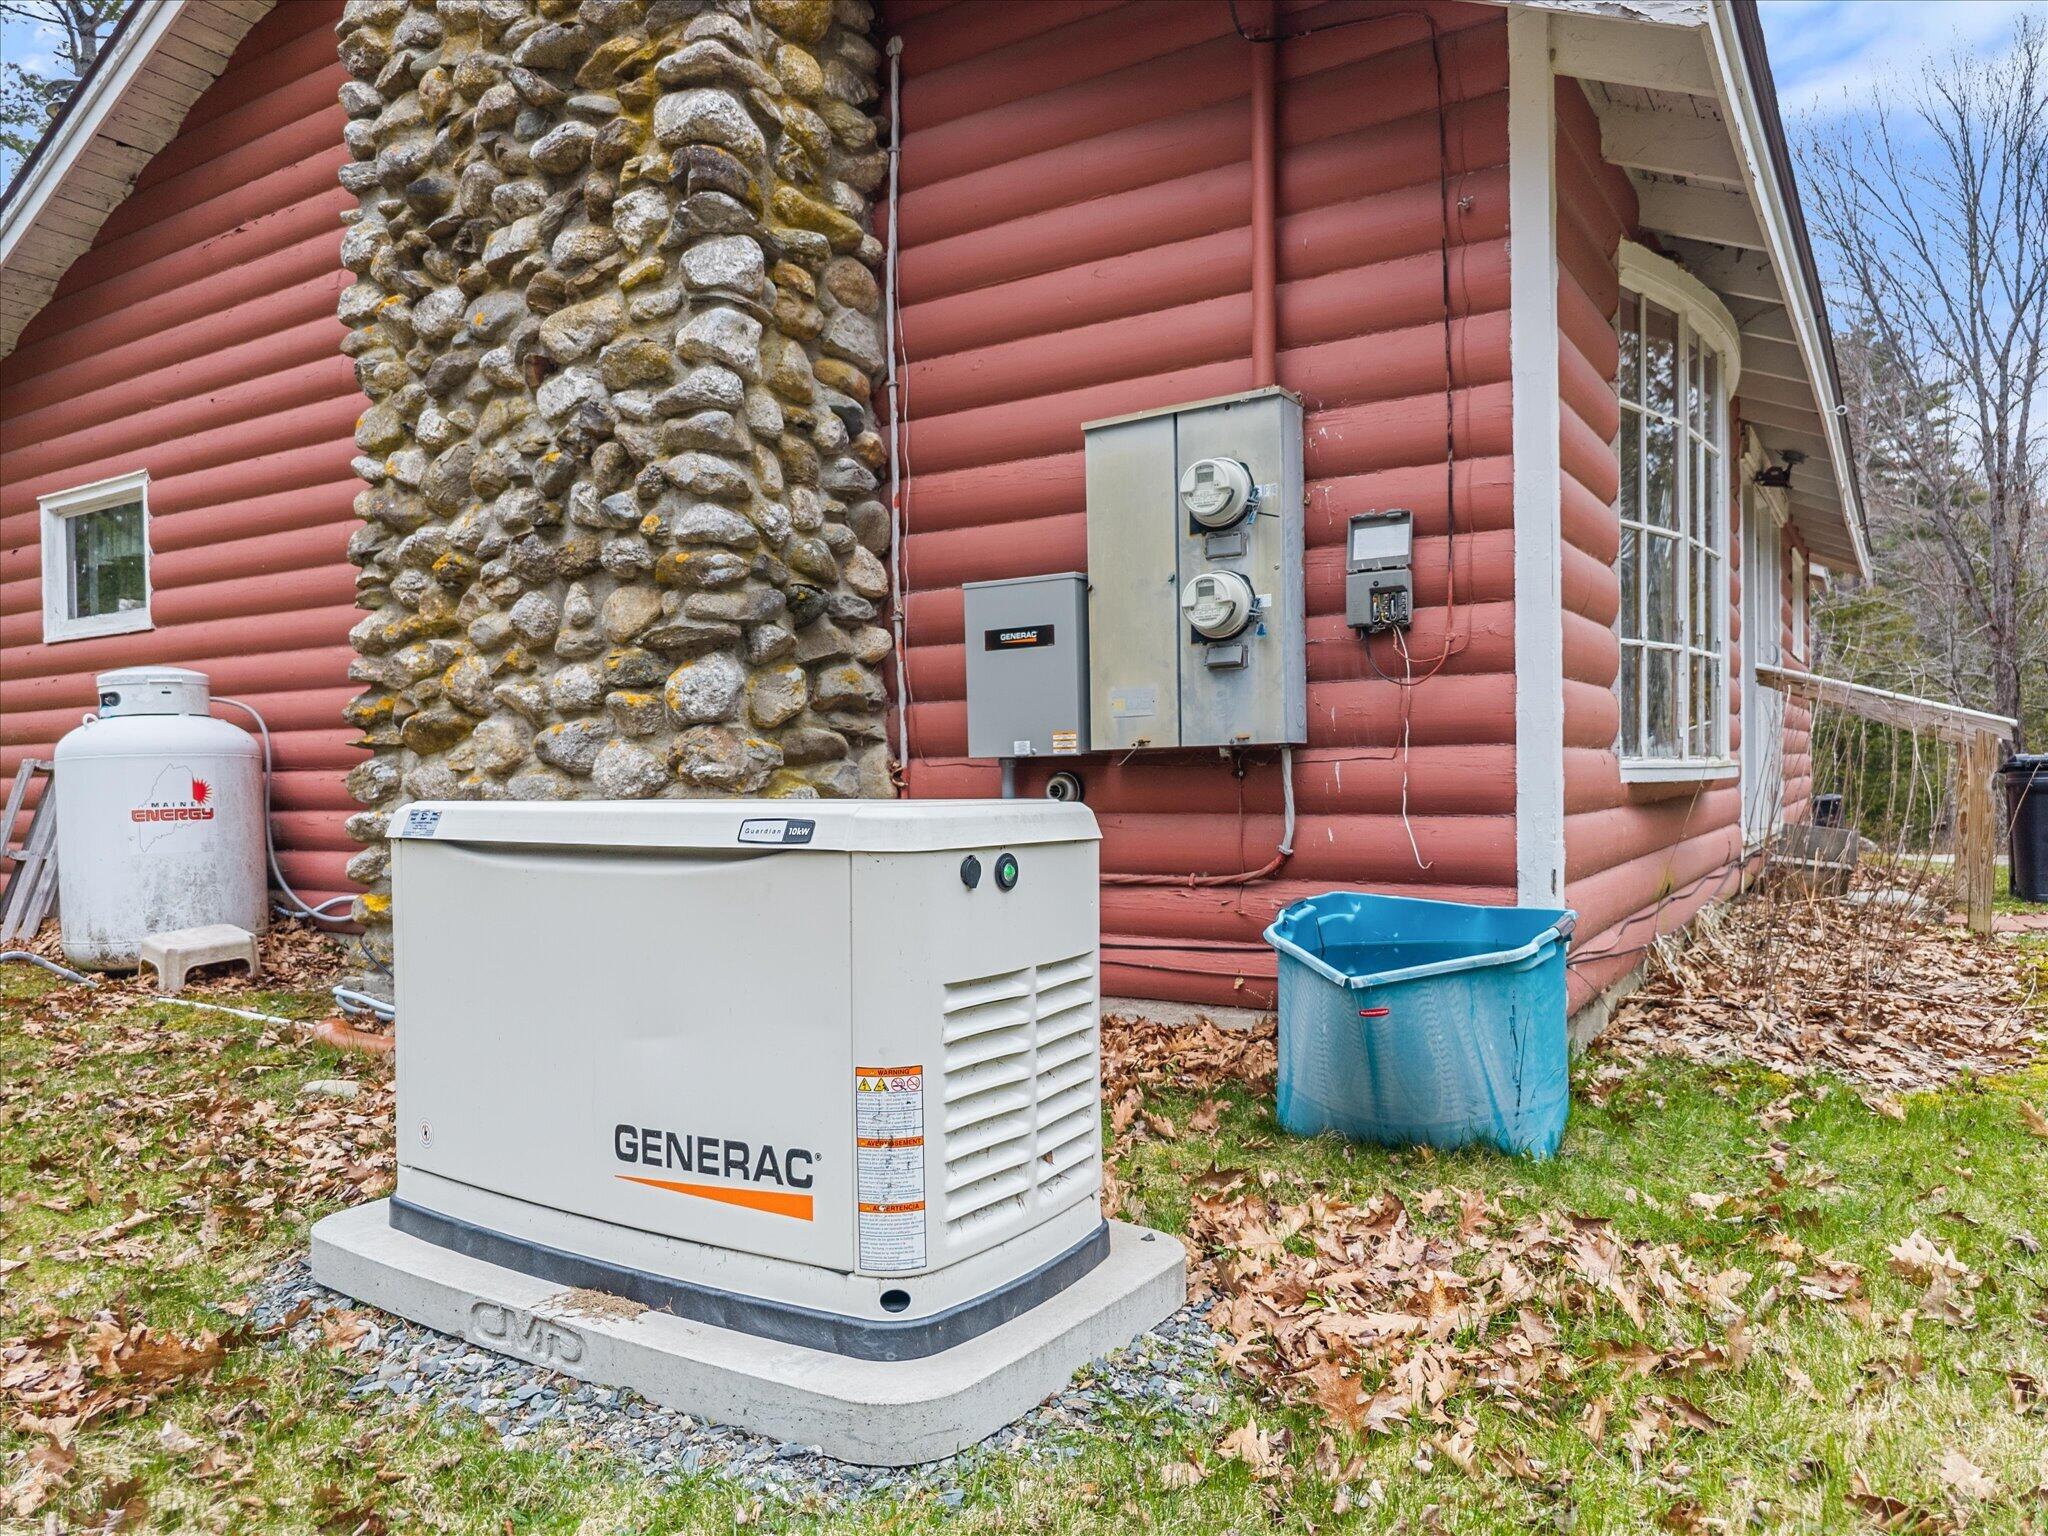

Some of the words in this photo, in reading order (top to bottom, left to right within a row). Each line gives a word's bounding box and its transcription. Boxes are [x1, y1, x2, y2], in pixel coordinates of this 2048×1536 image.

[1000, 631, 1037, 640] GENERAC
[132, 808, 214, 822] ENERGY
[788, 827, 811, 836] 10kW
[877, 1069, 910, 1077] WARNING
[866, 1138, 921, 1147] AVERTSEMENT
[614, 1123, 814, 1189] GENERAC
[872, 1203, 920, 1212] ADERTENCIA
